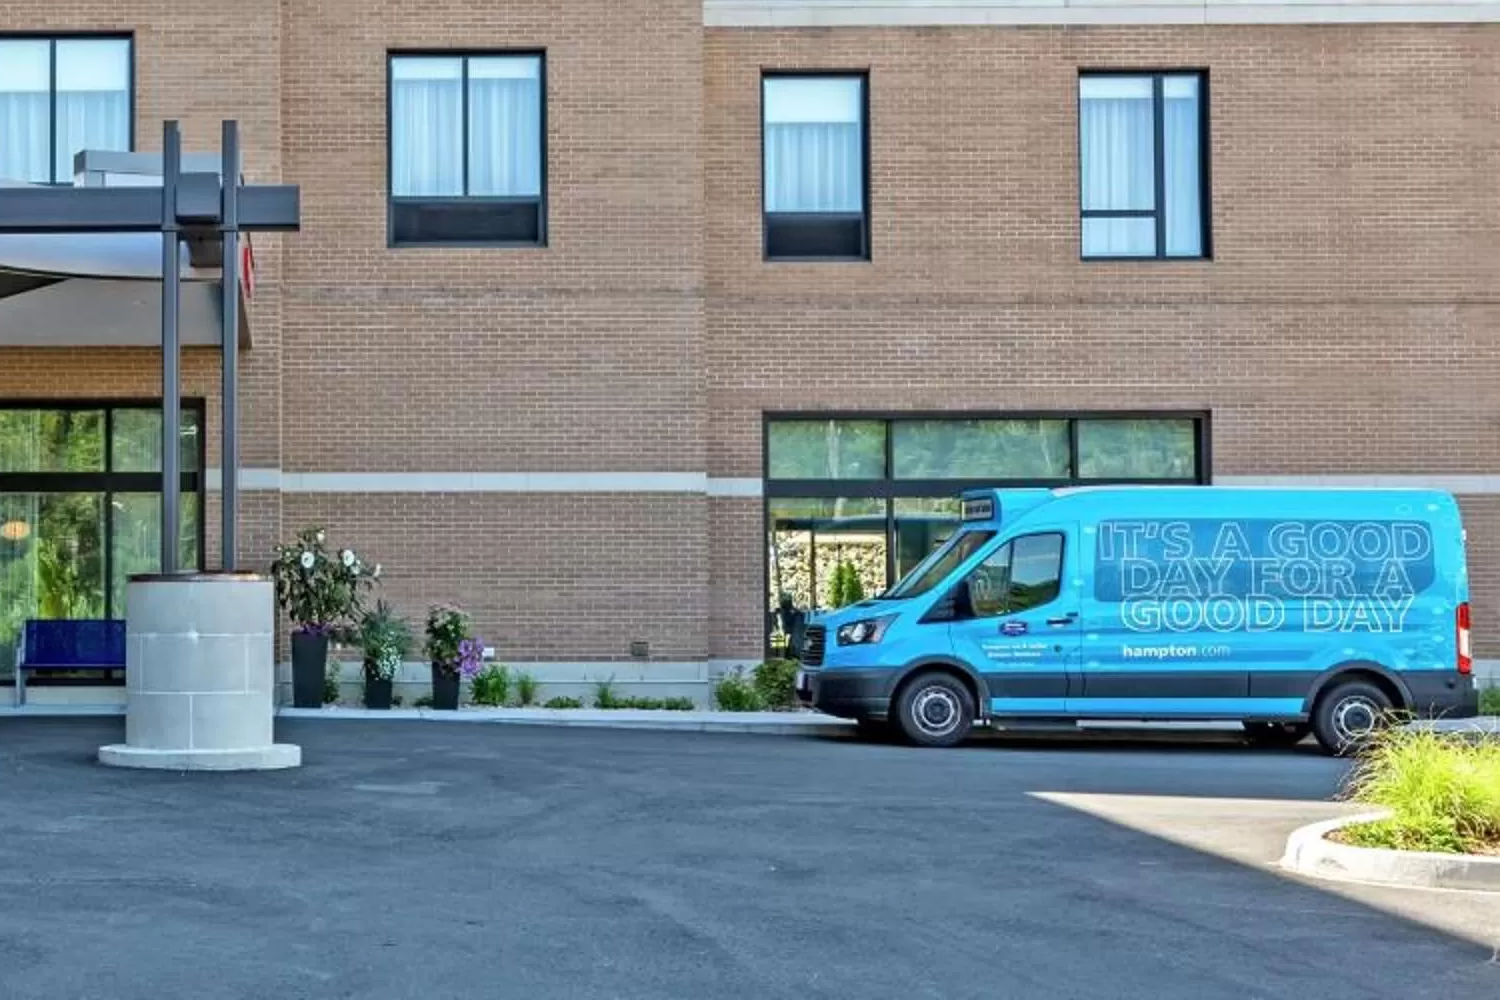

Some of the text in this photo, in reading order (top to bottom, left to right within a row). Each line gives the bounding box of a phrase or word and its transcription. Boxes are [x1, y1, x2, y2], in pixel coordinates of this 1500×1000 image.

[1099, 521, 1431, 561] IT'S A GOOD
[1121, 557, 1414, 597] DAY FOR A
[1121, 594, 1414, 632] GOOD DAY
[1122, 643, 1231, 659] hampton.com
